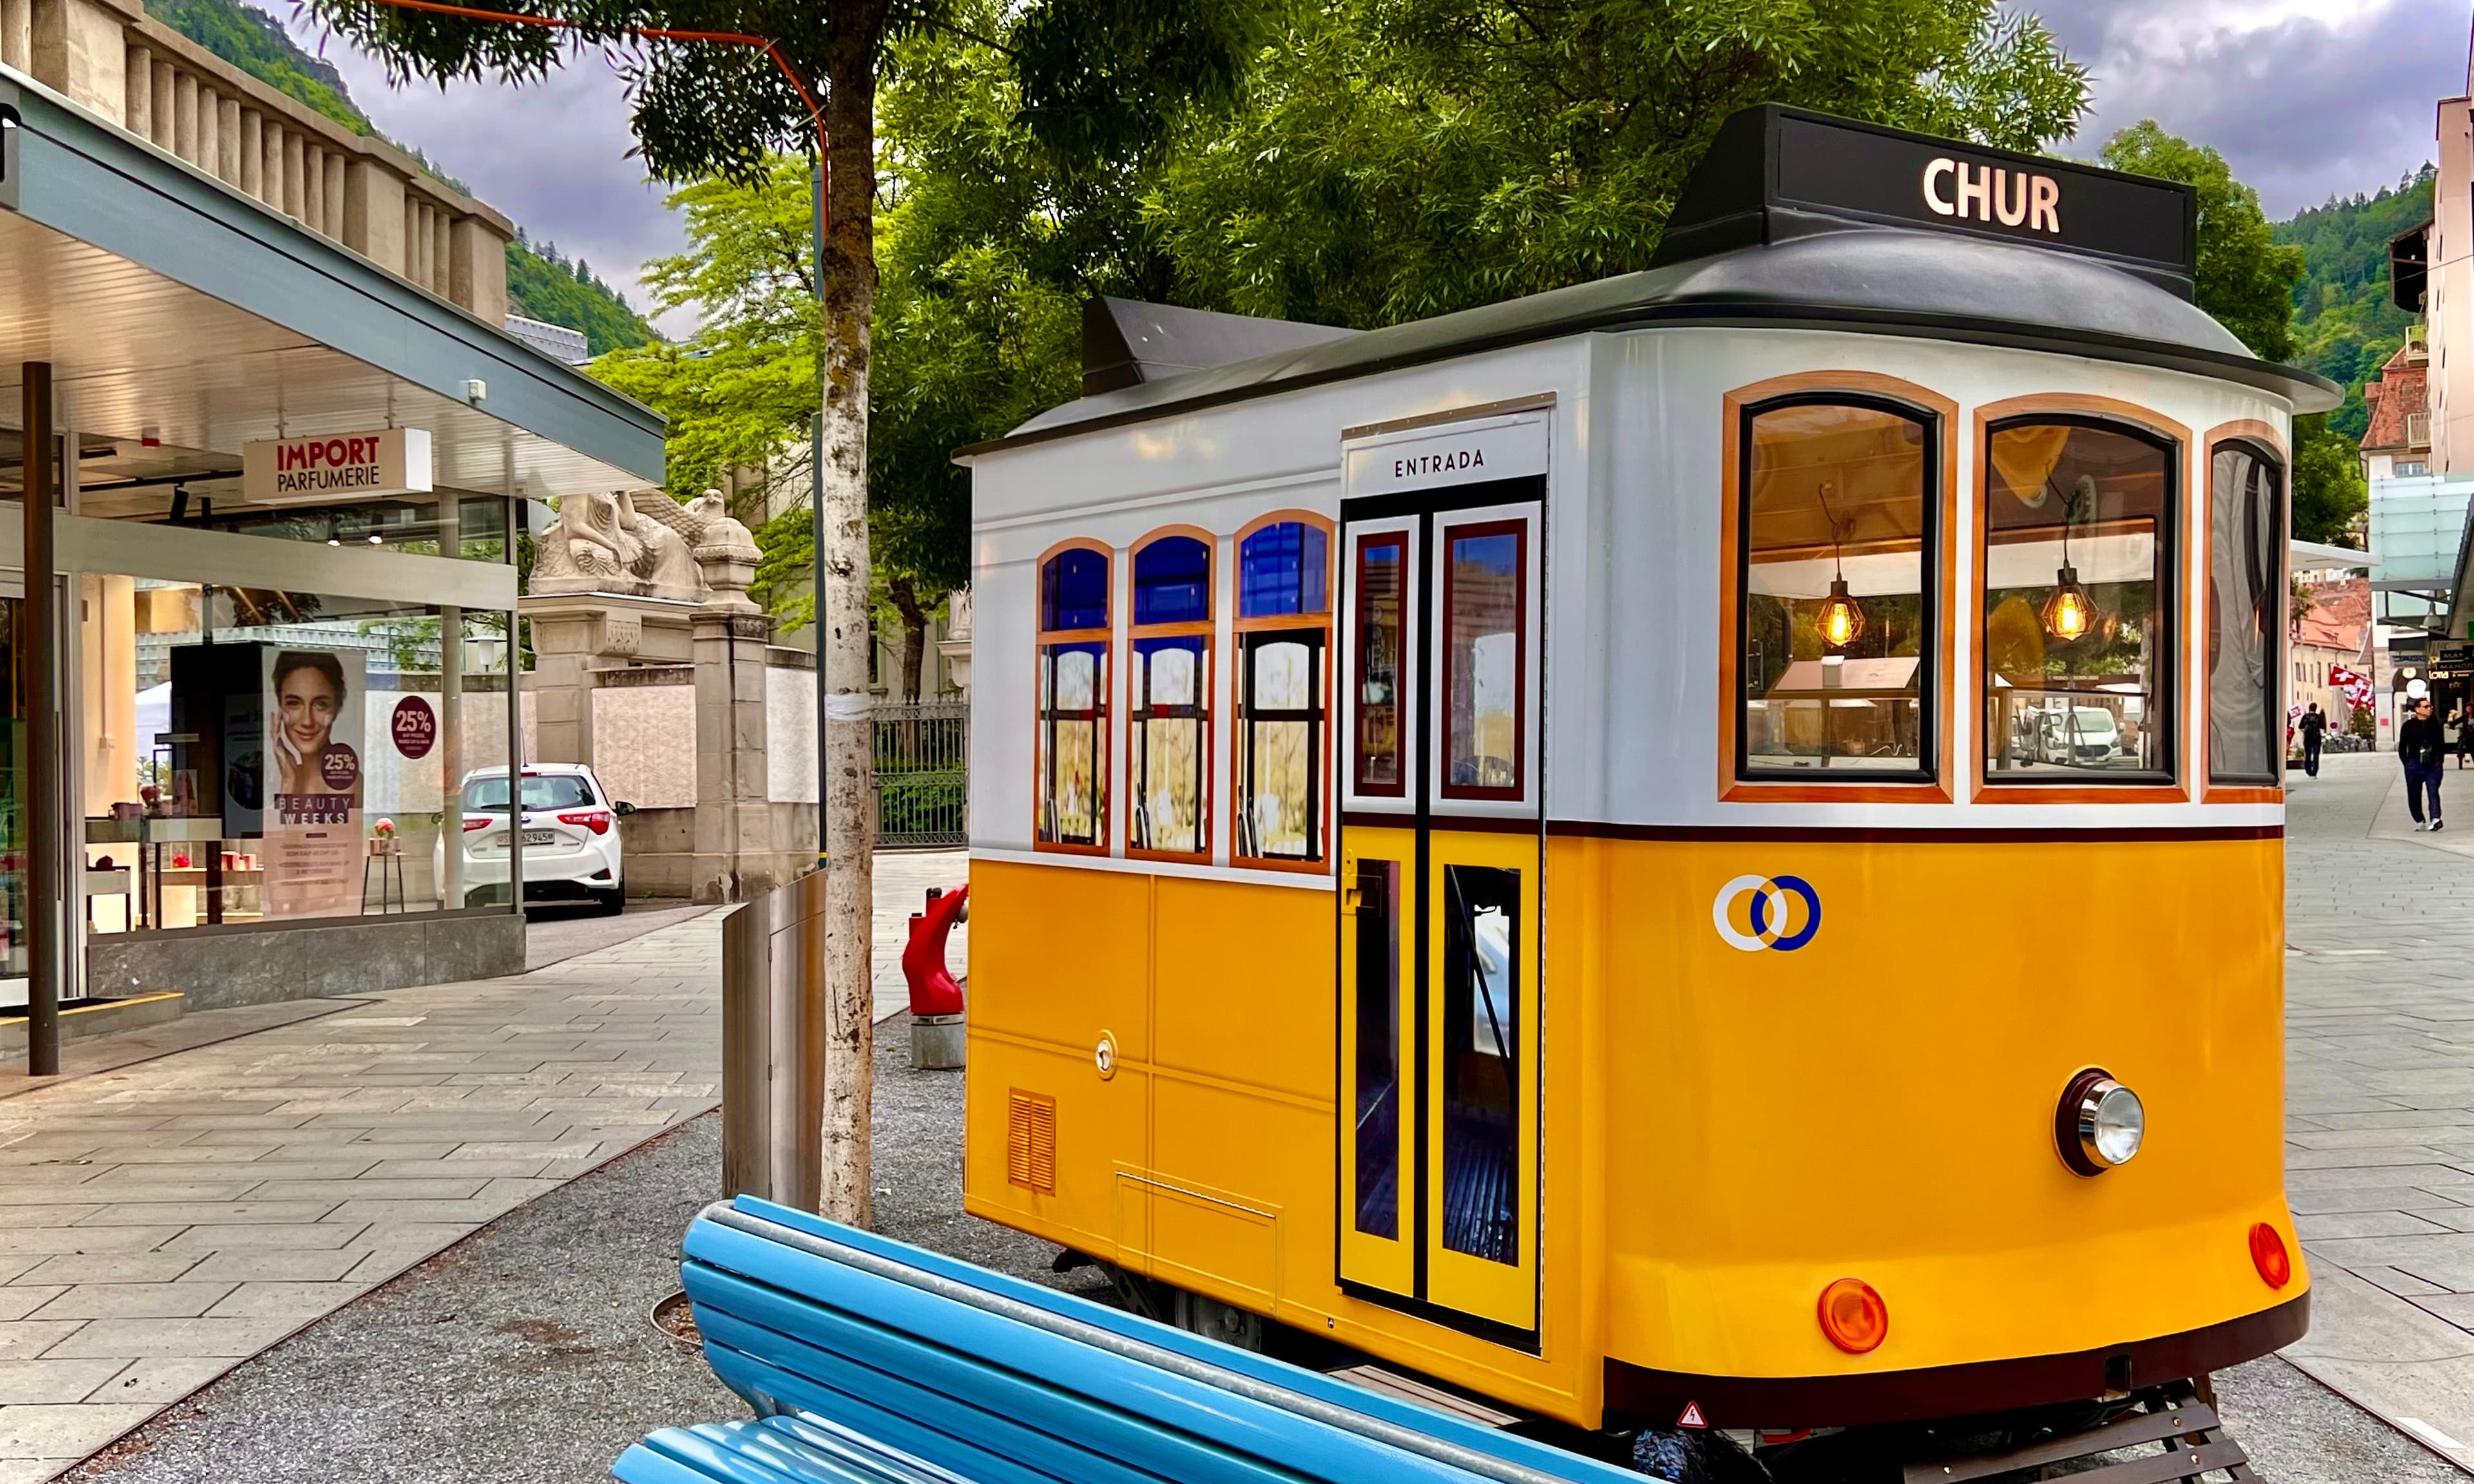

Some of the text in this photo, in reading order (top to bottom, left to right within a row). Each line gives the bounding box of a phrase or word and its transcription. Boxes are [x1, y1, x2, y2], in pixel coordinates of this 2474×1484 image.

[1924, 158, 2060, 233] CHUR
[277, 437, 379, 471] IMPORT
[1395, 449, 1484, 477] ENTRADA
[278, 466, 379, 492] PARFUMERIE
[396, 710, 431, 732] 25%
[324, 754, 356, 770] 25%
[278, 797, 350, 810] BEAUTY
[284, 812, 345, 825] WEEKS
